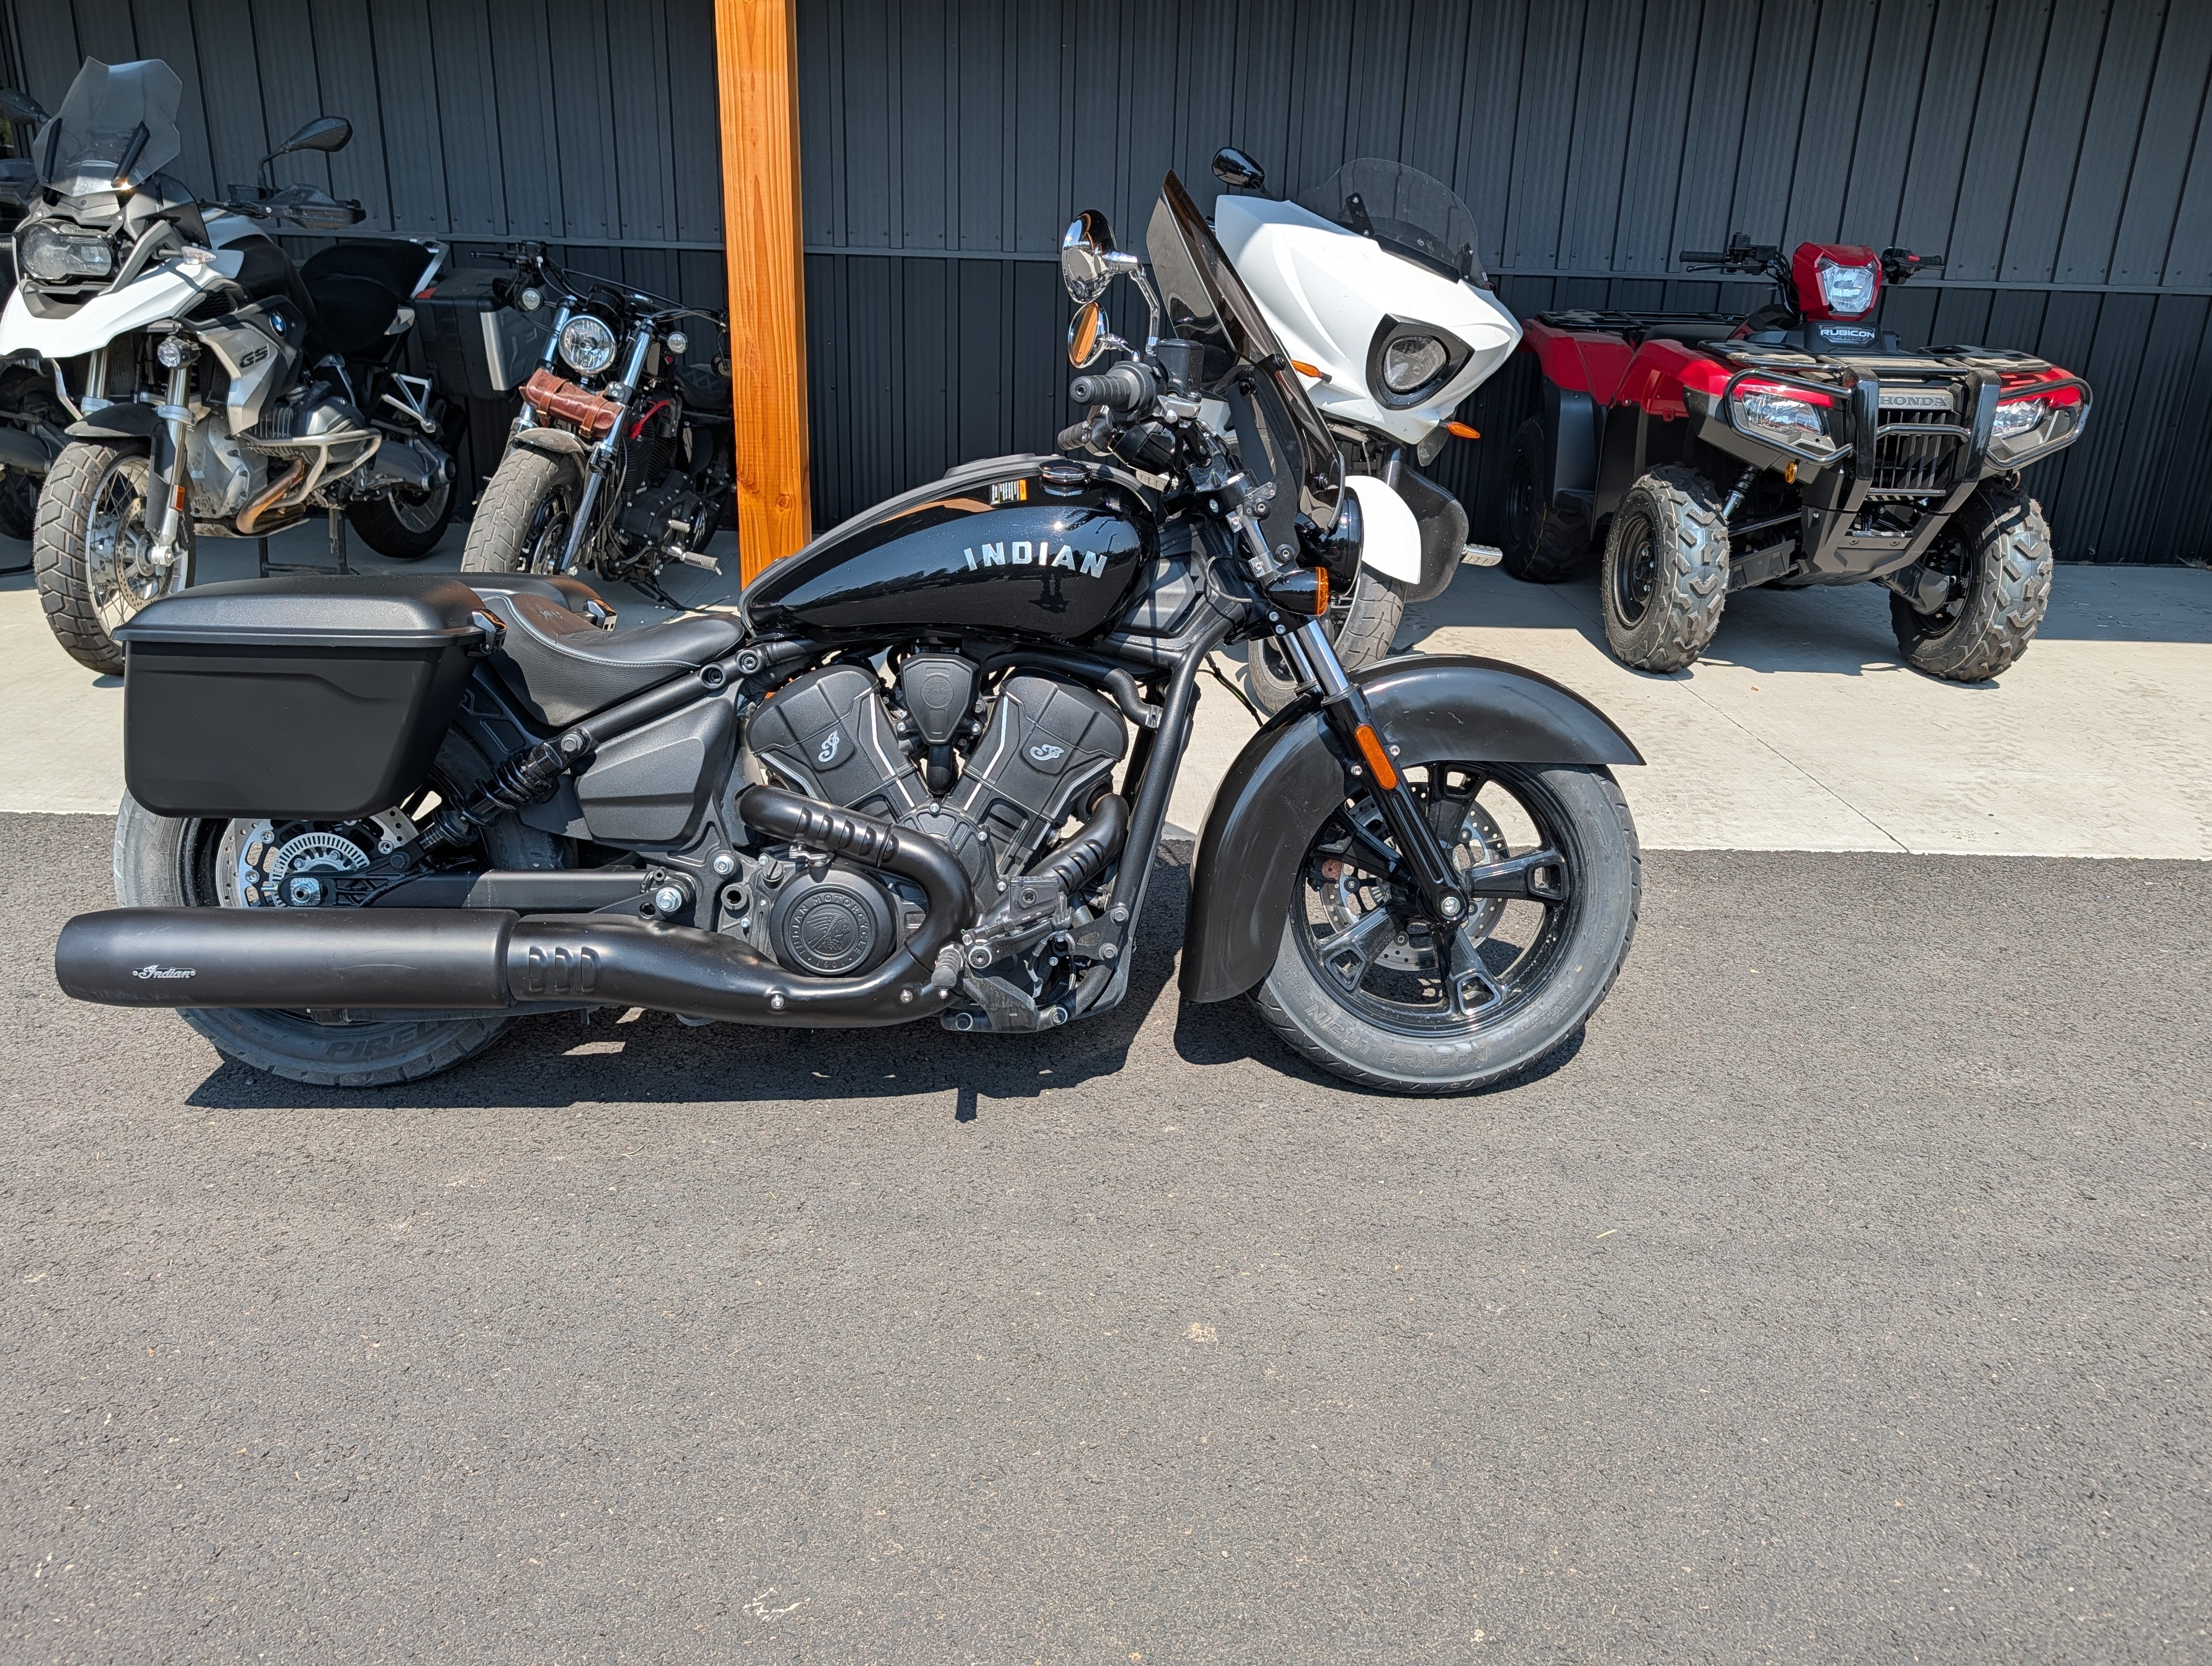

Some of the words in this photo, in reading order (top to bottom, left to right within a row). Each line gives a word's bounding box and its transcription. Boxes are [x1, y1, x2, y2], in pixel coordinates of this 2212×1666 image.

[1821, 329, 1875, 338] RUBICON
[239, 345, 269, 368] GS
[1879, 396, 1947, 407] HONDA
[963, 541, 1107, 579] INDIAN
[792, 904, 808, 954] INDIAN
[812, 894, 868, 954] MOTORCYCLE
[138, 965, 190, 979] Indian
[816, 959, 845, 968] 1901
[1304, 1003, 1376, 1054] NIGHT
[1382, 1046, 1487, 1069] DRAGON
